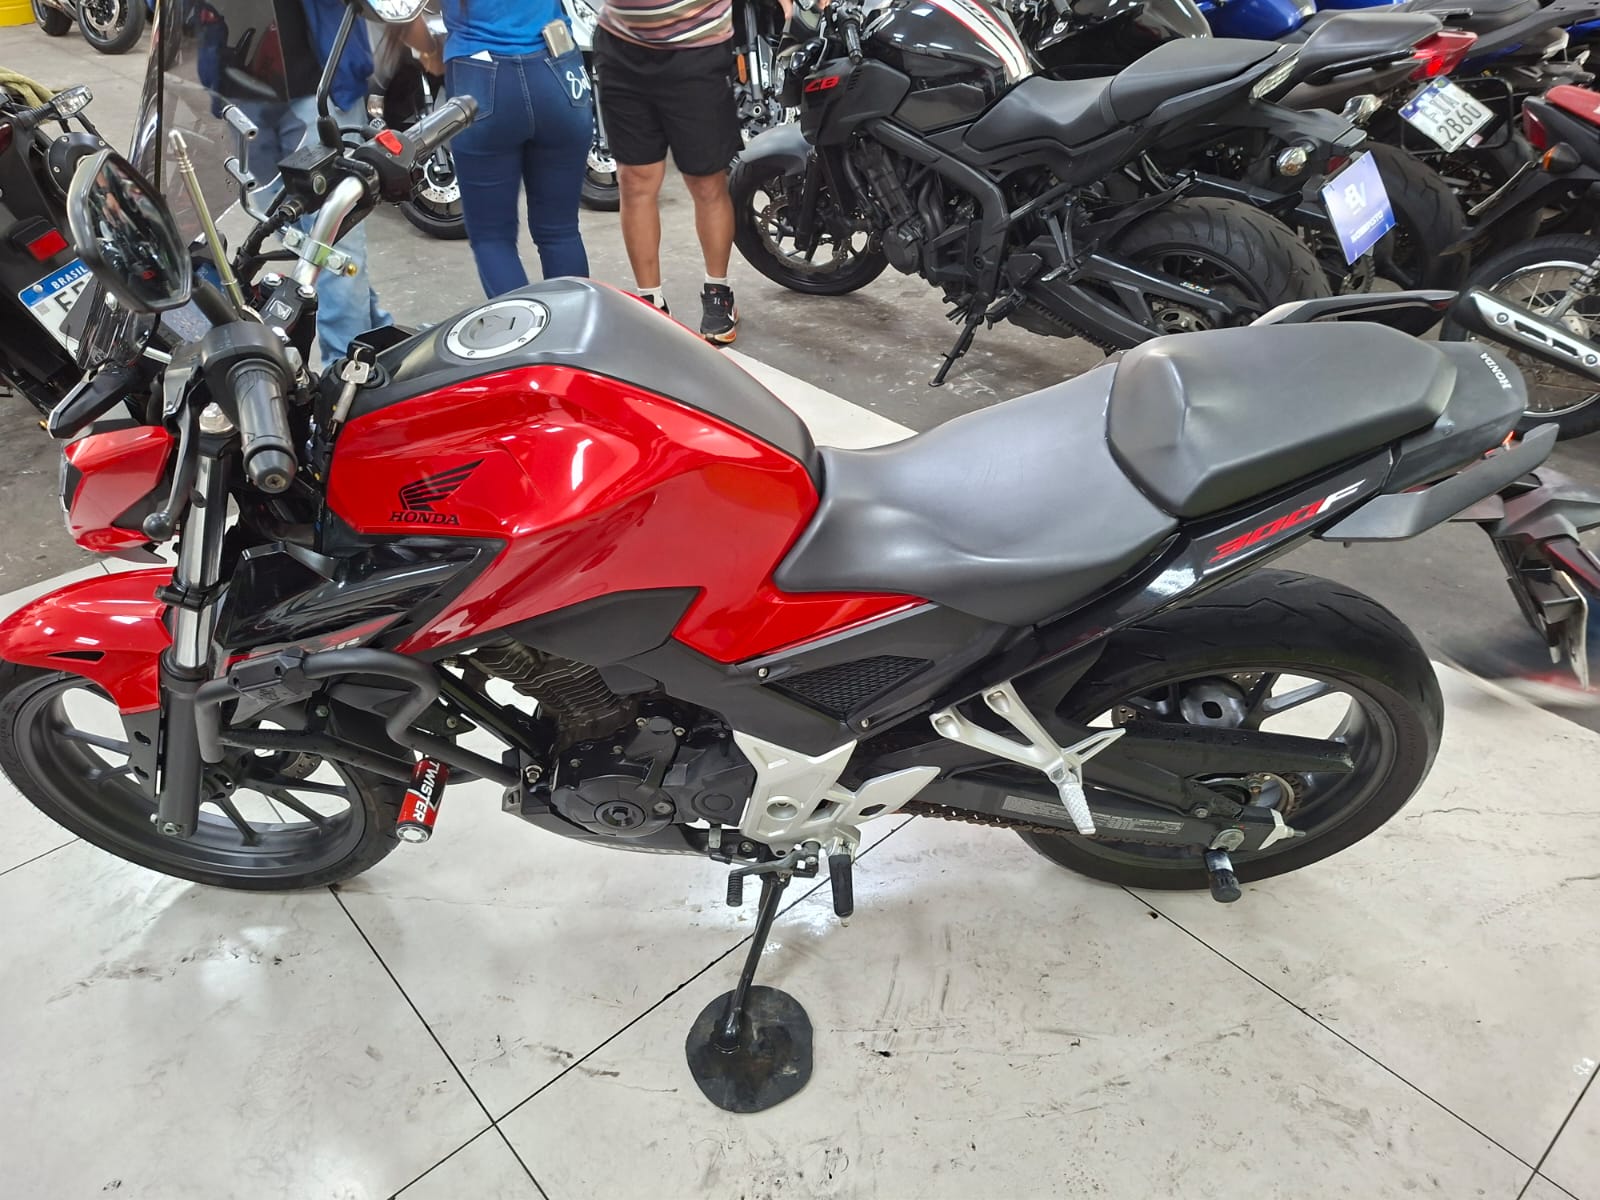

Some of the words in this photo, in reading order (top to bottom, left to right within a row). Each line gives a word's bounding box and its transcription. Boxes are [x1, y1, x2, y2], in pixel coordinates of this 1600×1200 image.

[804, 75, 840, 92] CB
[1437, 102, 1482, 142] 2B60
[51, 265, 89, 290] BRASIL
[1480, 353, 1512, 389] HONDA
[389, 511, 459, 526] HONDA
[1209, 478, 1366, 564] 300F
[413, 760, 440, 822] TWISTER
